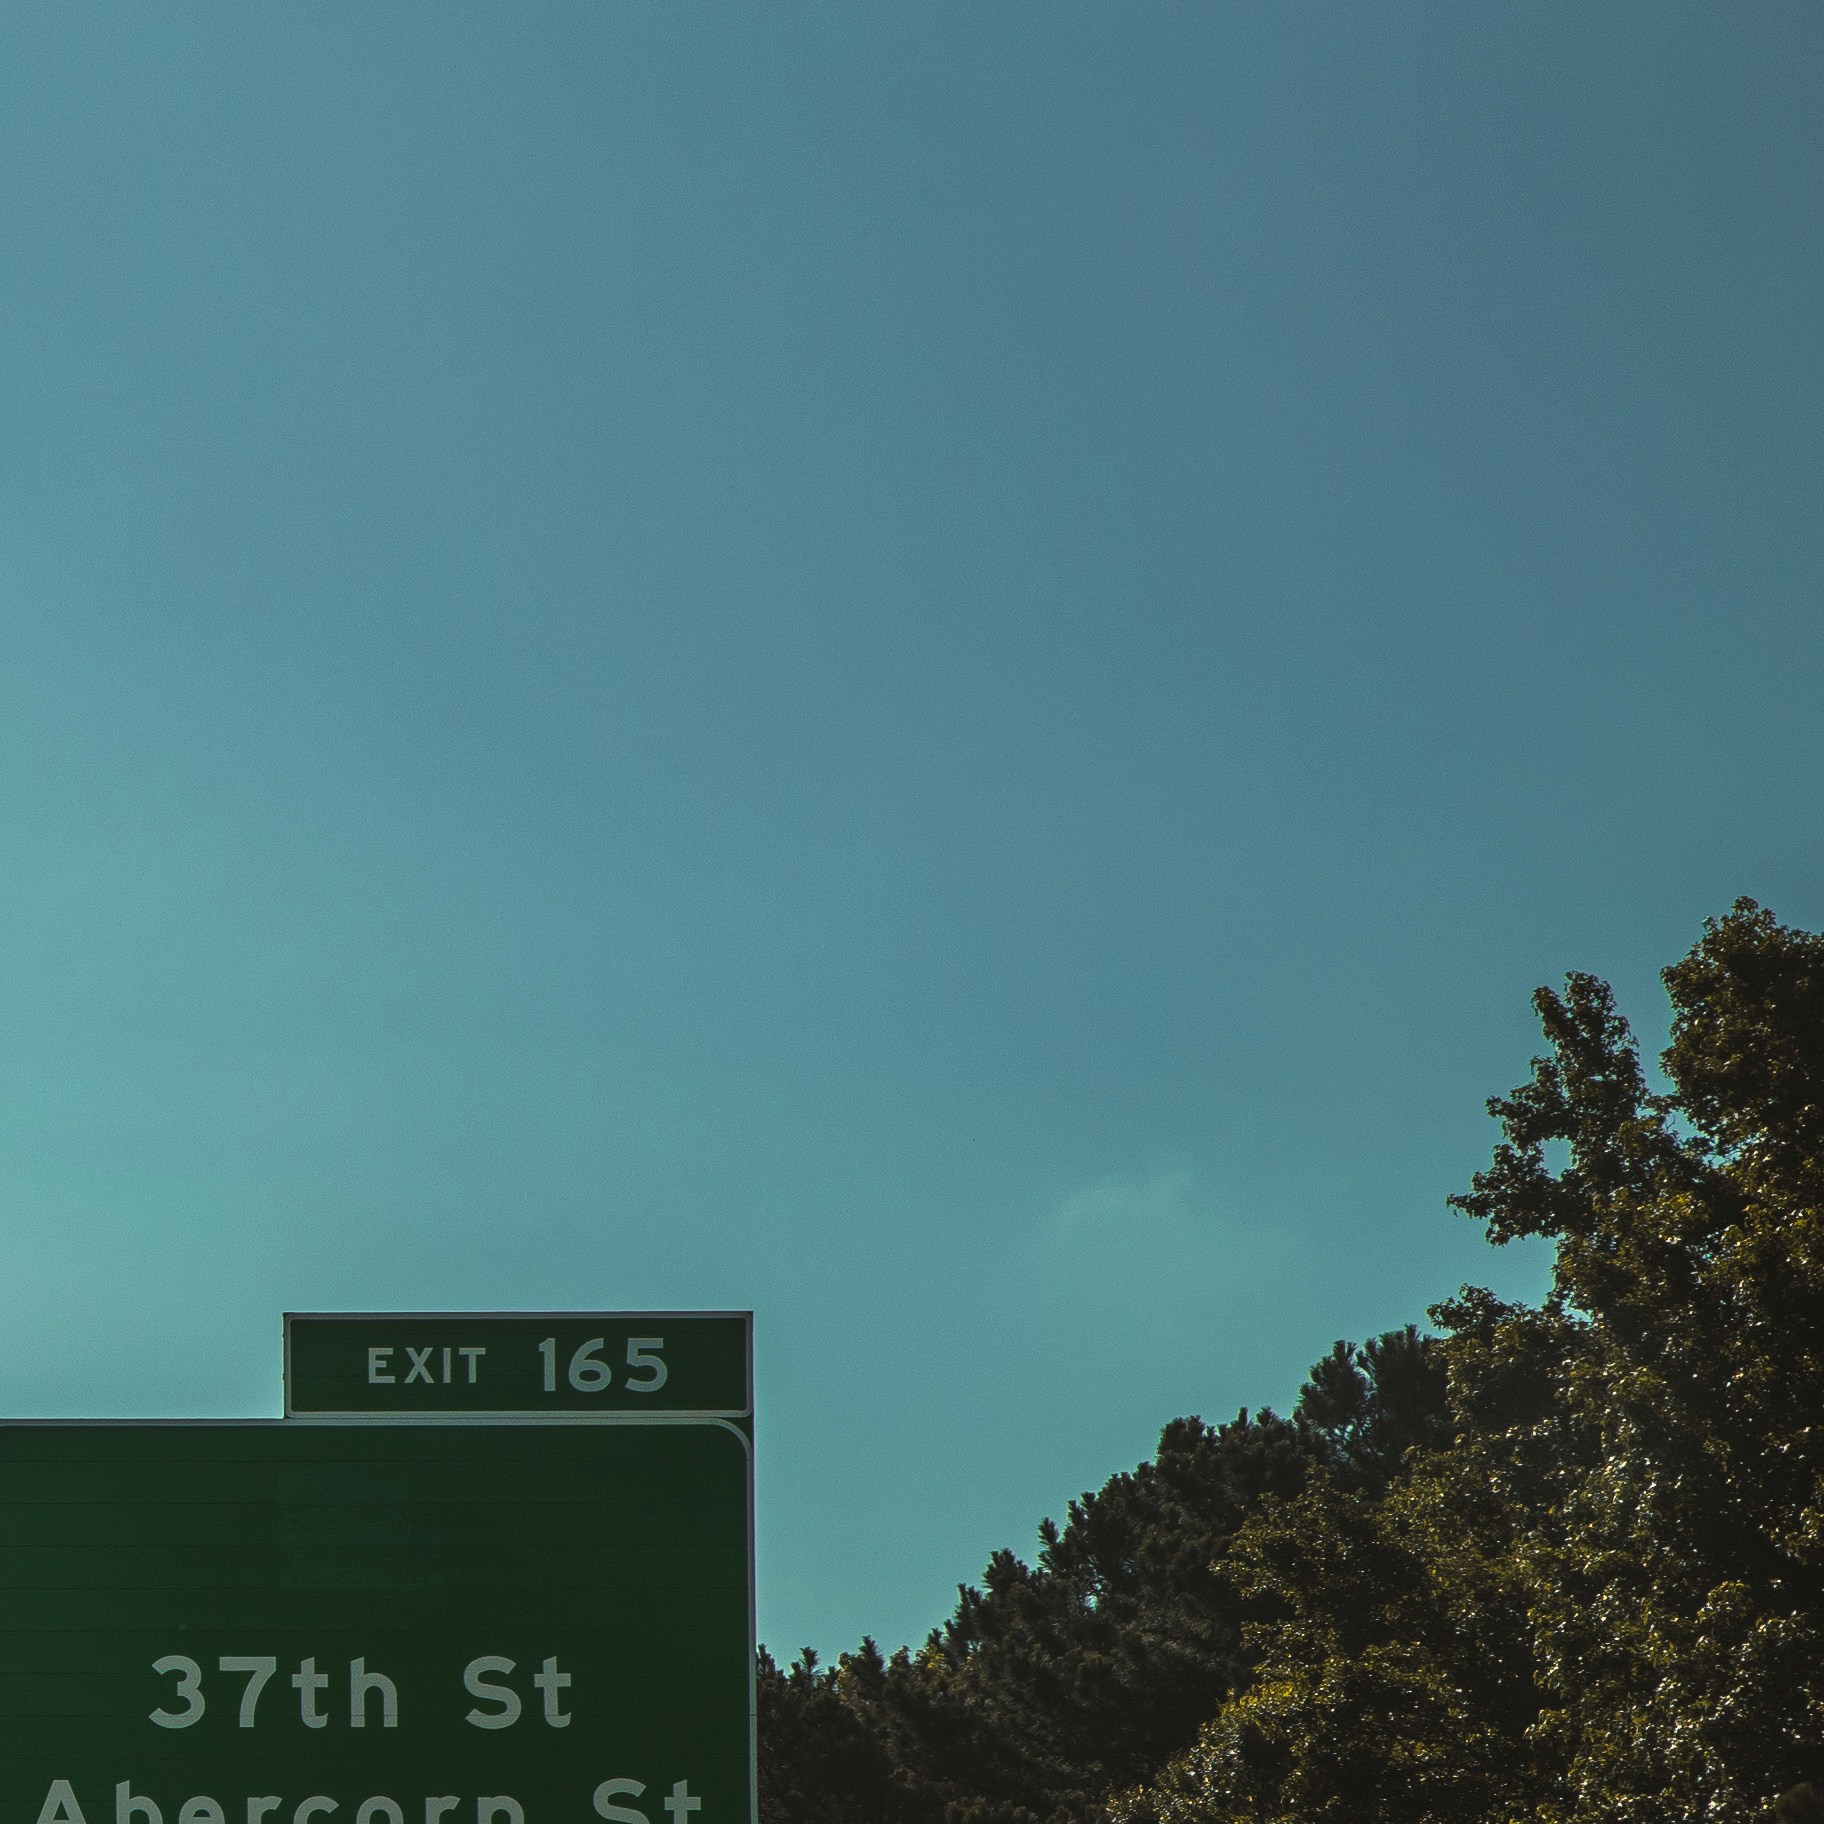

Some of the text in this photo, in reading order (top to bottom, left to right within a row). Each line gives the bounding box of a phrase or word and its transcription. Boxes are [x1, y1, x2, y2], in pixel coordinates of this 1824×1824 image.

[368, 1337, 668, 1393] EXIT 165
[148, 1654, 572, 1730] 37th St
